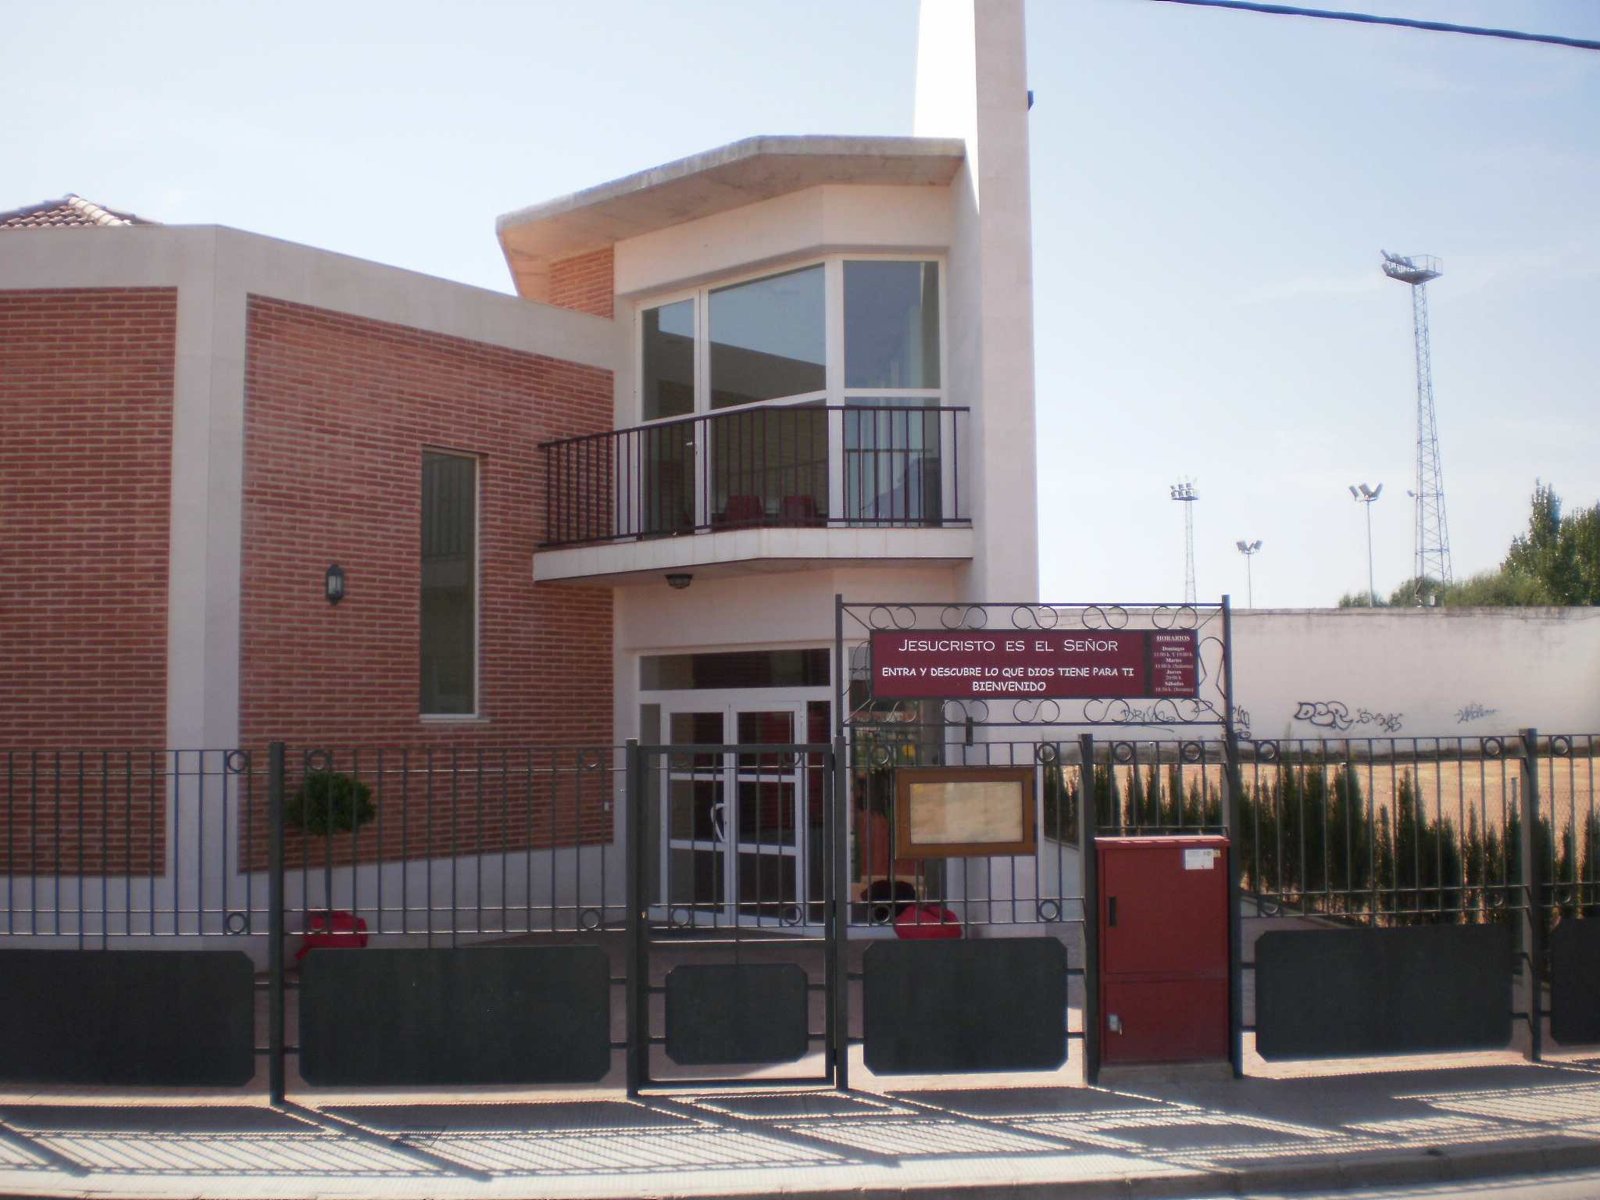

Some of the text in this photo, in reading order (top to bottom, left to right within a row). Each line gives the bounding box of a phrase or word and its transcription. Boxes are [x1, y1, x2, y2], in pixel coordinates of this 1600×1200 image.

[899, 638, 1119, 652] JESUCRISTO ES EL SEÑOR
[882, 667, 1135, 678] ENTRA Y DESCUBRE LO QUE DIOS TIENE PARA TI
[972, 681, 1047, 692] BIENVENIDO
